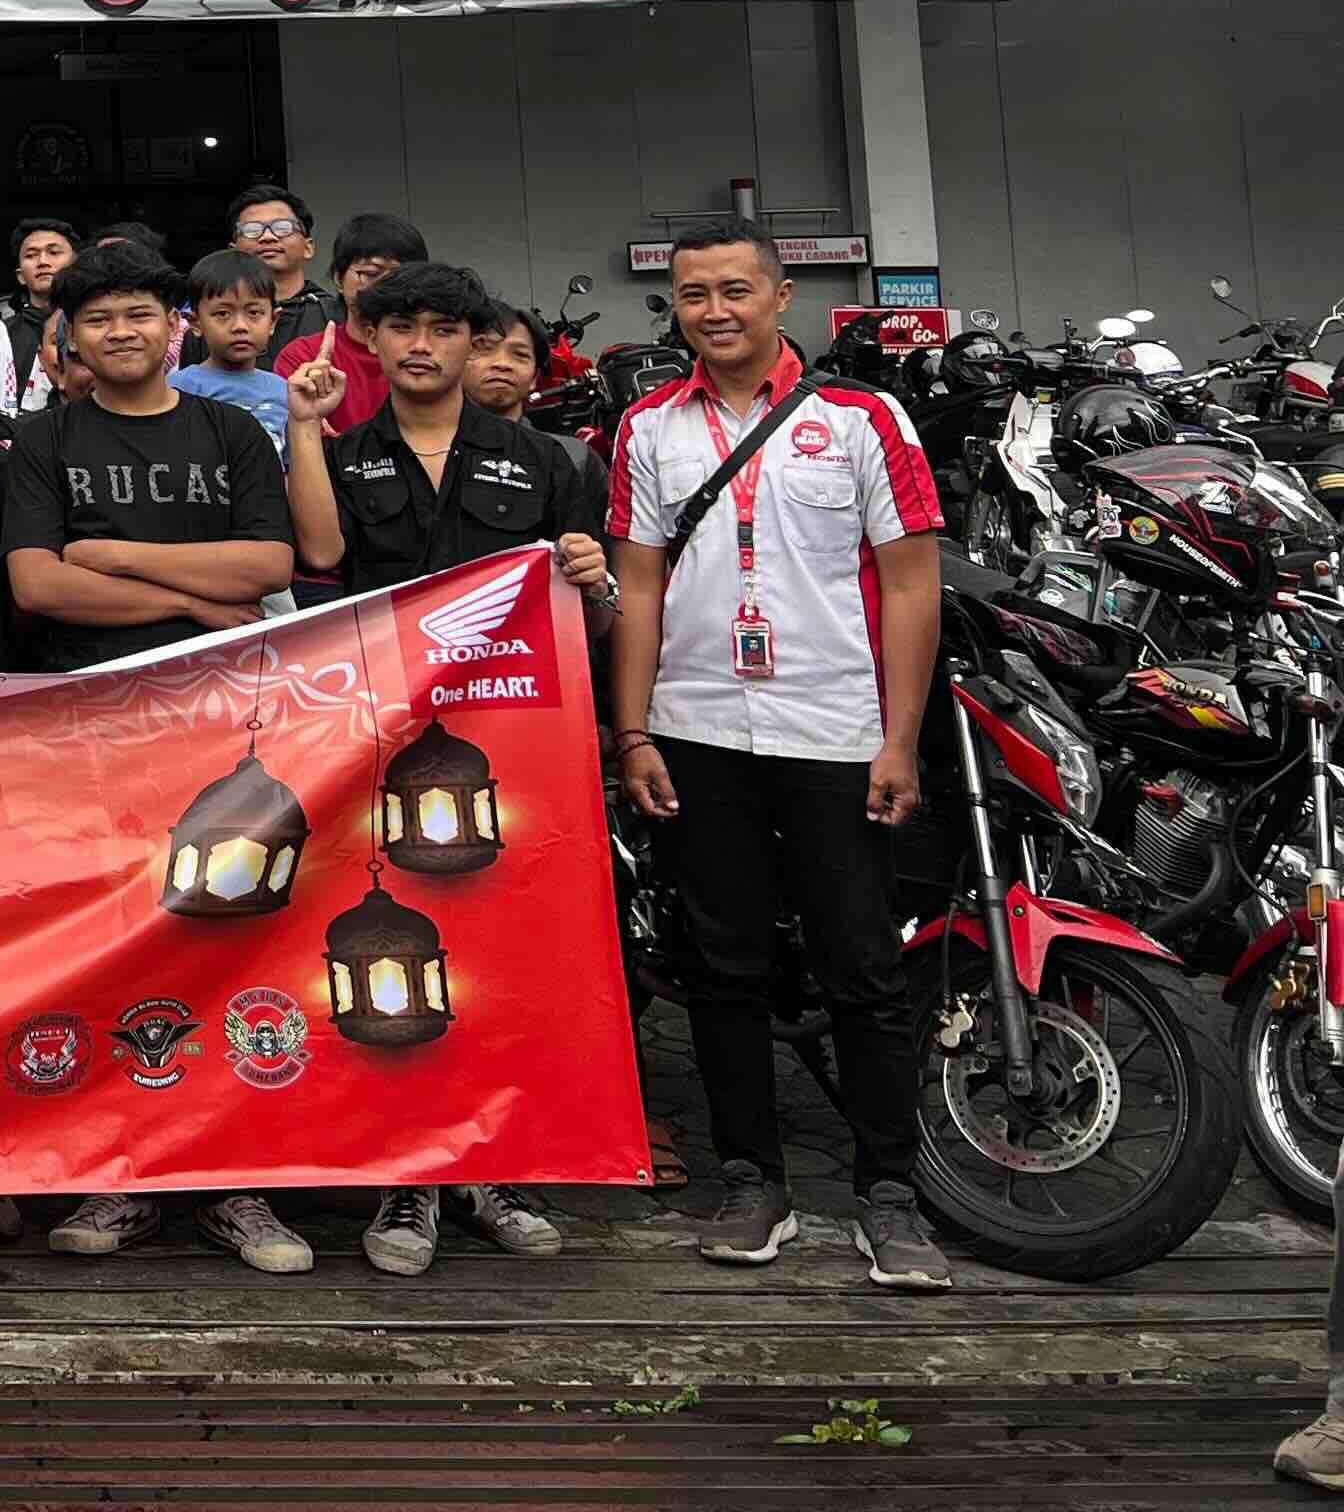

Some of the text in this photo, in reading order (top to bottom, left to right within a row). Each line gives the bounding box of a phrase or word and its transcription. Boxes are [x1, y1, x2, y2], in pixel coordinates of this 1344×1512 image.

[882, 283, 934, 295] PARKIR
[879, 296, 938, 306] SERVICE
[425, 639, 534, 664] HONDA
[431, 676, 539, 705] One HEART.
